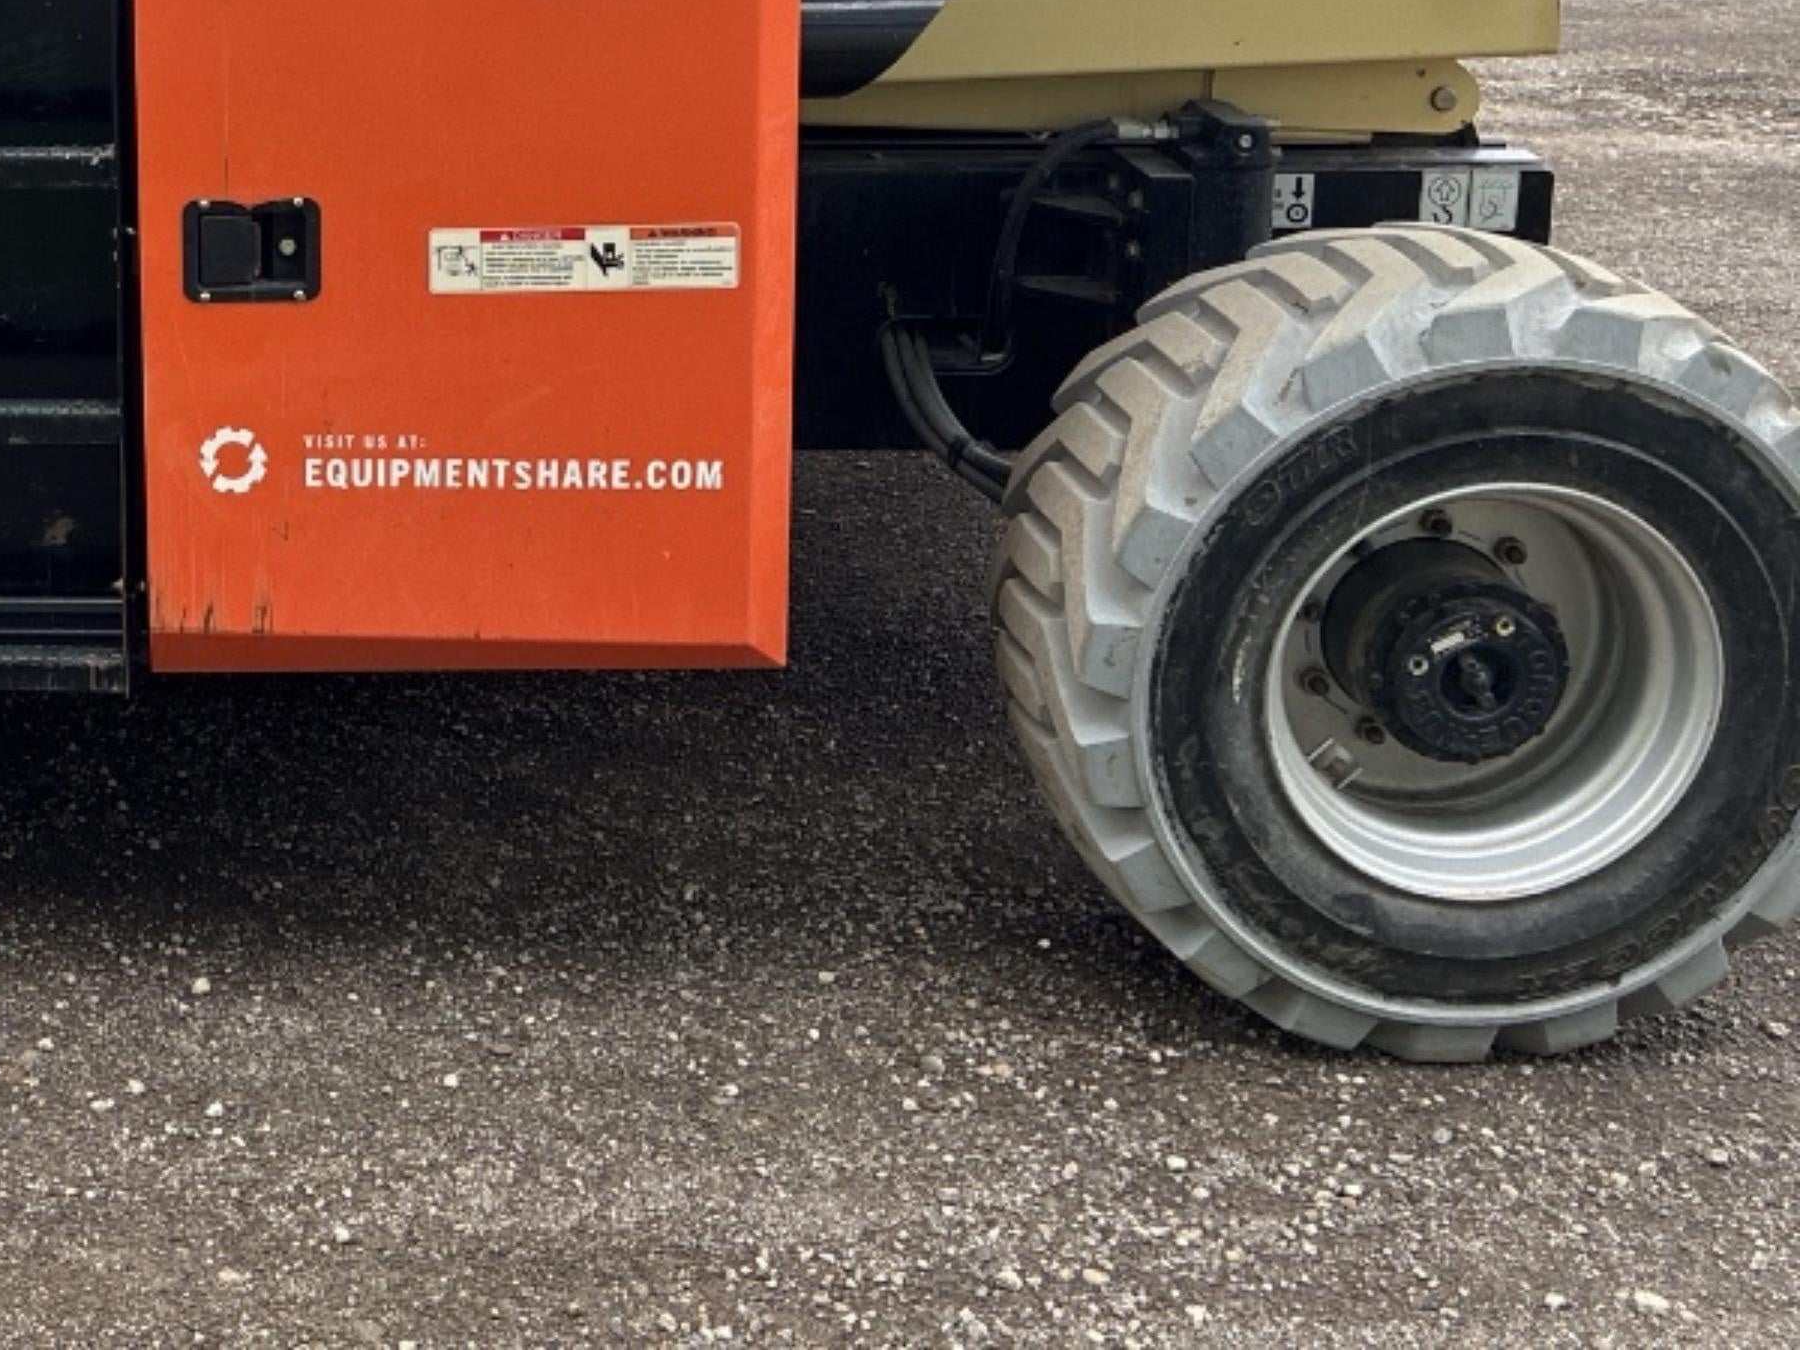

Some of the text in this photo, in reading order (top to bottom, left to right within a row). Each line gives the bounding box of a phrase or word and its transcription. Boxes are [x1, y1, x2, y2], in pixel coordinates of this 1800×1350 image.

[302, 433, 428, 450] VISIT US AT:
[304, 457, 725, 492] EQUIPMENTSHARE.COM
